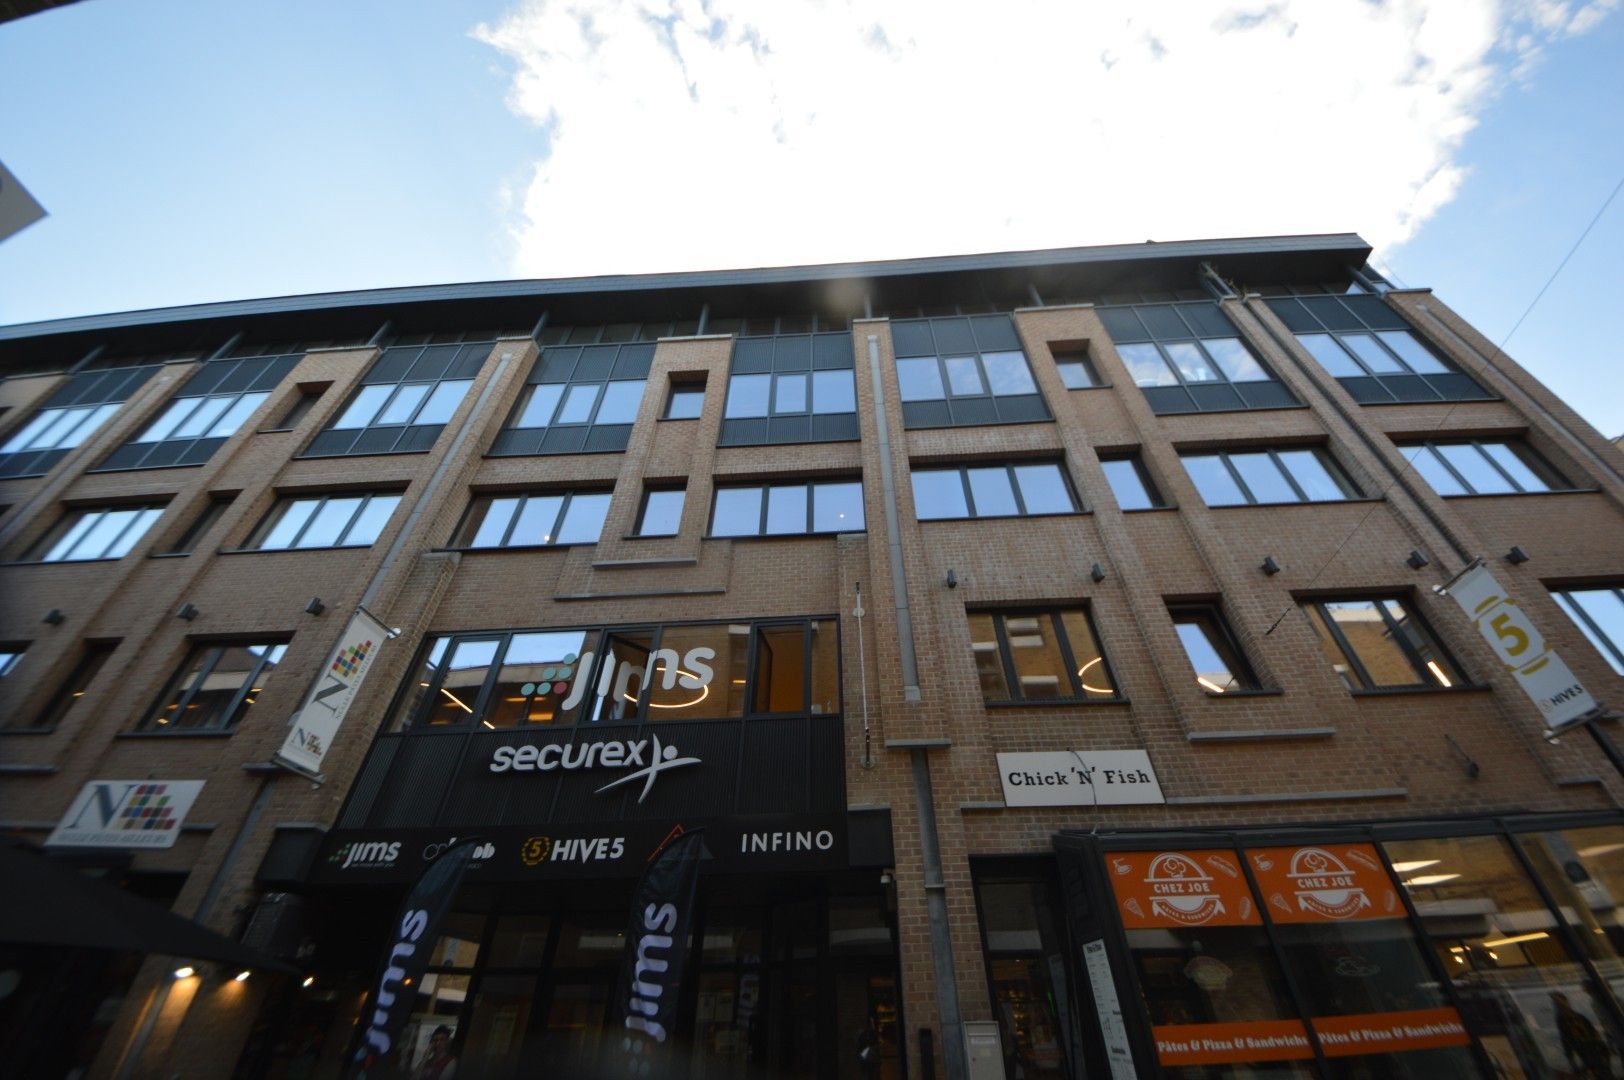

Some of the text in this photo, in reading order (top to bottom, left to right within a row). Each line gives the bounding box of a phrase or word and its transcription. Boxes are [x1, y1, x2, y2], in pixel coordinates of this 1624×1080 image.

[1490, 613, 1529, 656] 5
[490, 739, 648, 773] securex
[1103, 769, 1151, 784] Fish
[741, 830, 834, 853] INFINO
[550, 837, 625, 864] HIVE5
[1154, 882, 1211, 893] CHEZ JOE
[1297, 876, 1354, 889] CHEZ JOE
[1361, 1028, 1393, 1041] Pizza
[1201, 1038, 1233, 1051] Pizza
